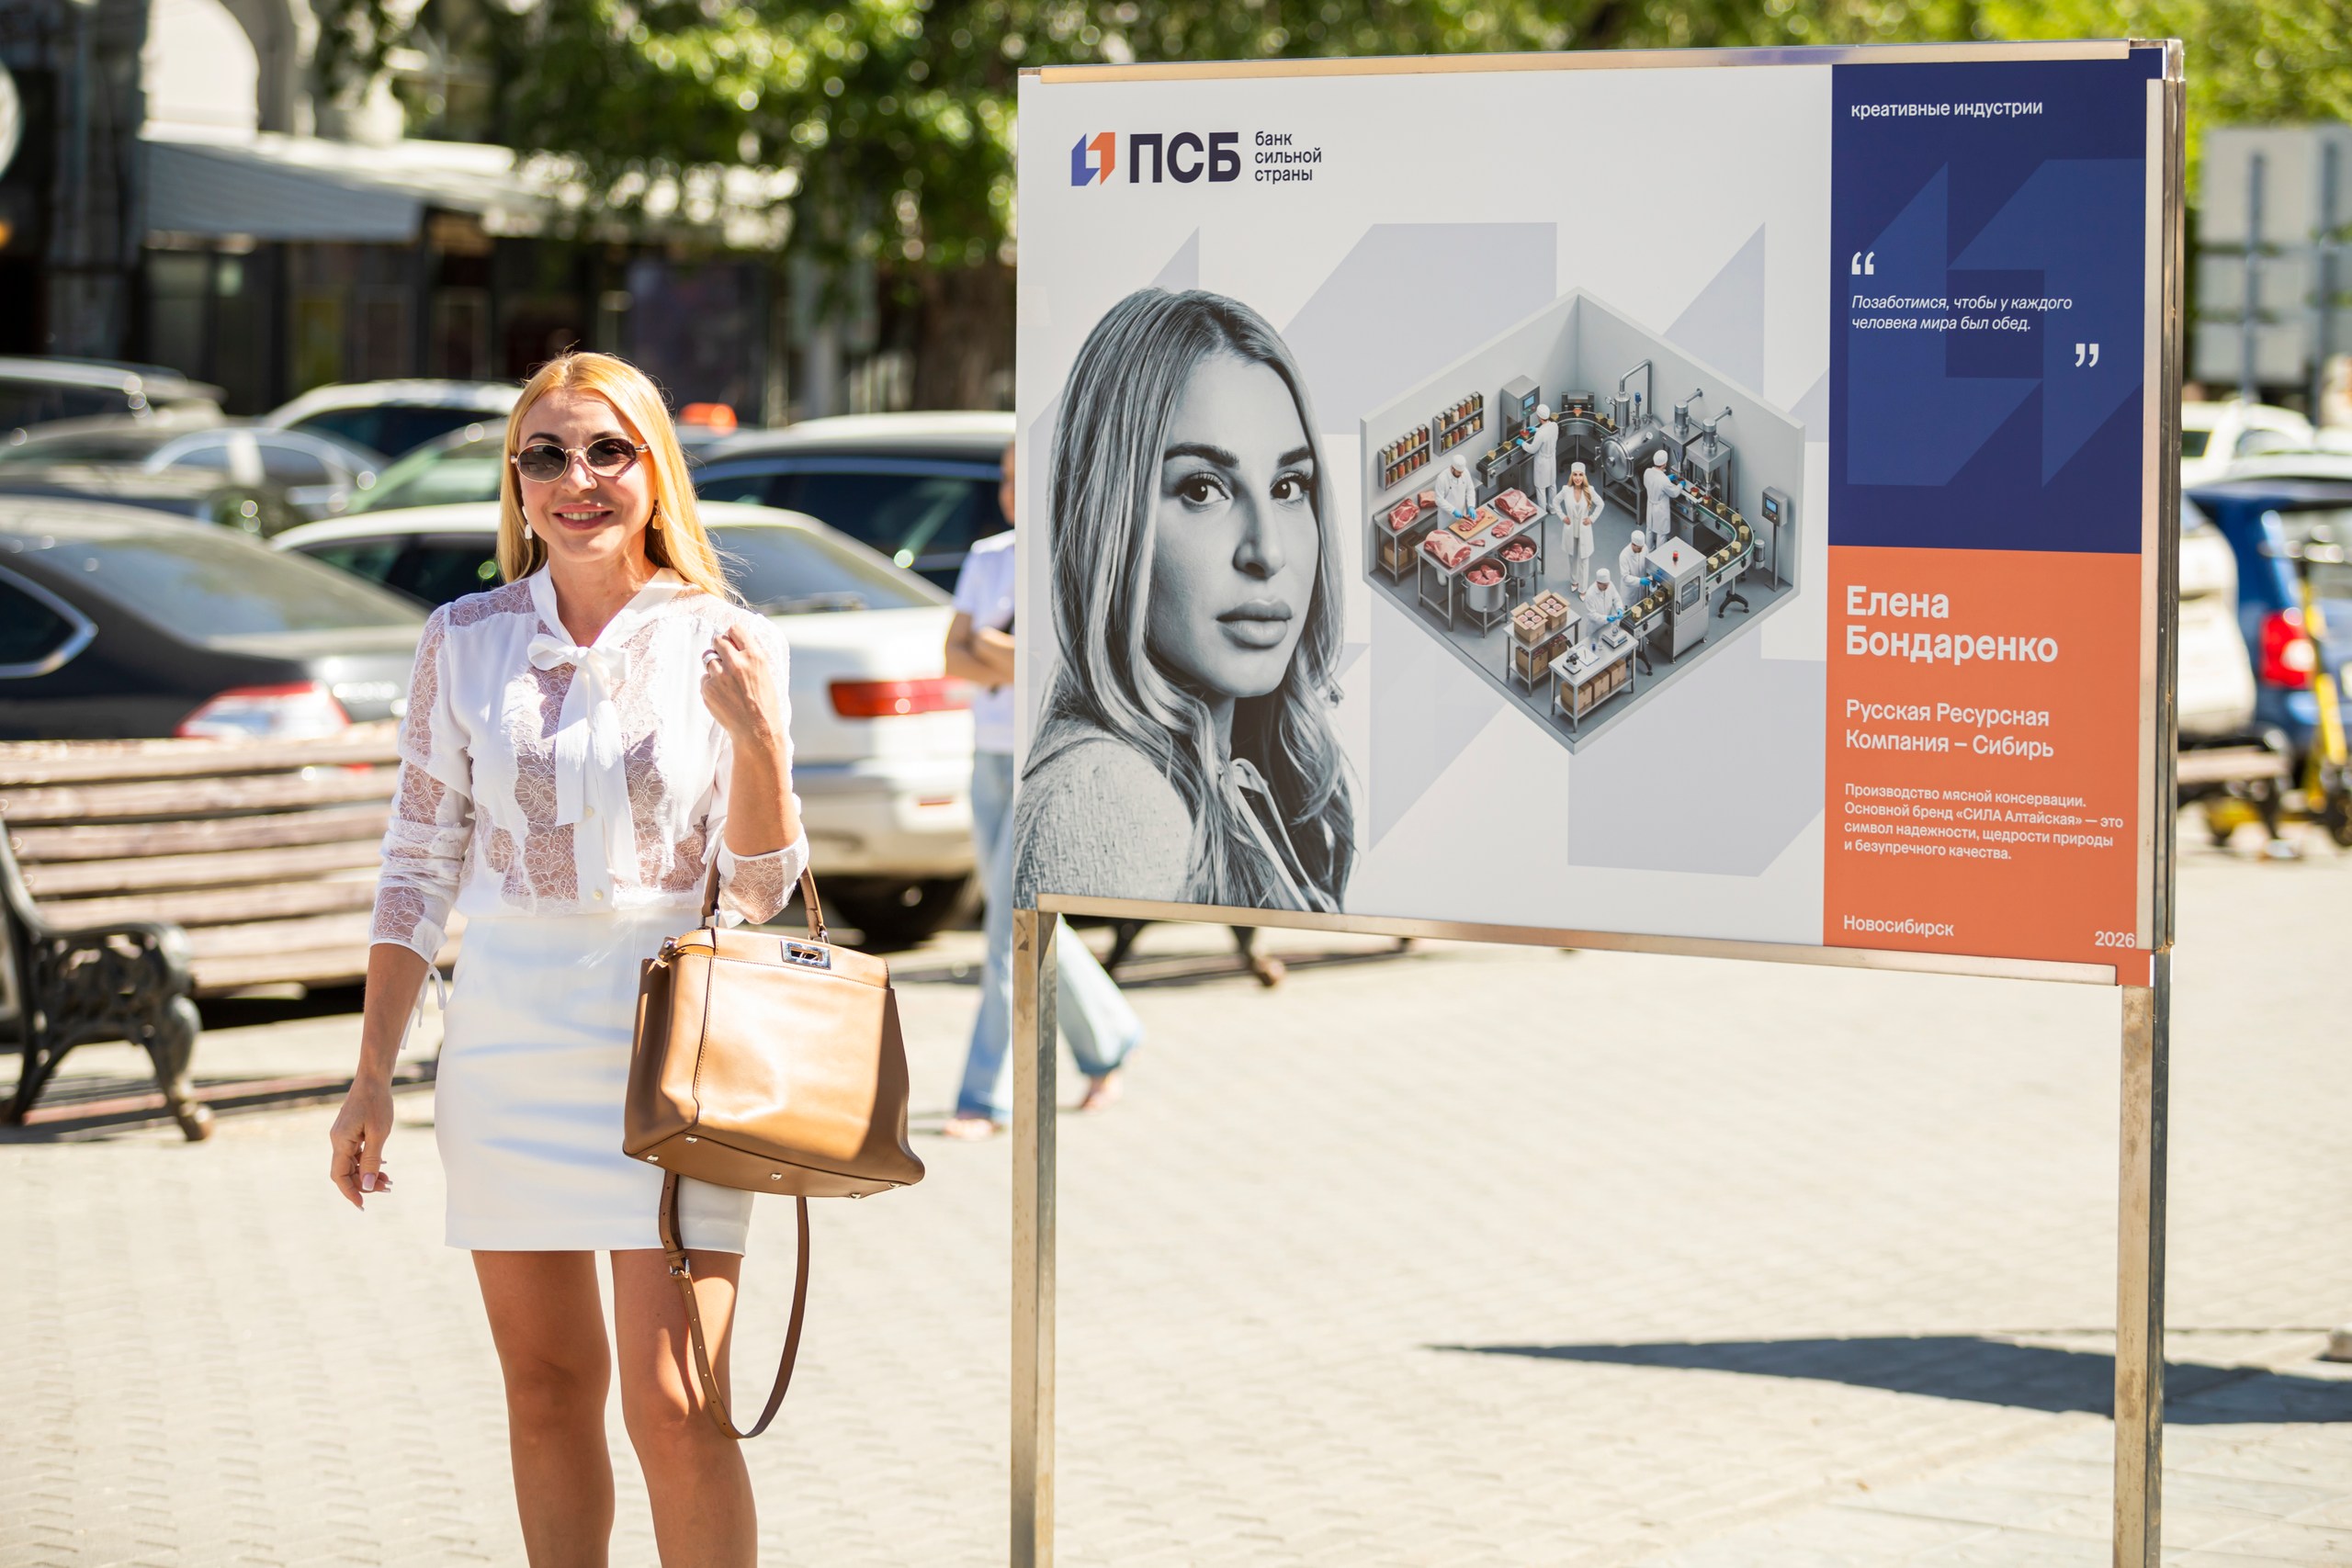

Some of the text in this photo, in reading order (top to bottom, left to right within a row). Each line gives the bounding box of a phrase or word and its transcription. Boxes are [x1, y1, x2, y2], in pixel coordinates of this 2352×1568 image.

[1852, 102, 2042, 119] креативные индустрии
[1256, 131, 1292, 146] банк
[1130, 132, 1240, 183] ПСБ
[1255, 148, 1321, 164] сильной
[1255, 169, 1312, 185] страны
[1852, 296, 2072, 311] Позаботимся, чтобы у каждого
[1852, 316, 2030, 332] человека мира был обед.
[1848, 585, 1949, 618] Елена
[1847, 625, 2058, 665] Бондаренко
[1847, 699, 2049, 728] Русская Ресурсная
[1847, 729, 1949, 751] Компания
[1973, 735, 2053, 761] Сибирь
[1846, 784, 2086, 807] Производство мясной консервации.
[1845, 802, 1909, 816] Основной
[1913, 806, 1953, 820] бренд
[1956, 807, 2002, 821] «СИЛА
[2005, 810, 2082, 825] Алтайская»
[2100, 818, 2123, 828] это
[1845, 823, 2113, 848] символ надежности, щедрости природы
[1845, 840, 2011, 859] и безупречного качества.
[1844, 915, 1953, 938] Новосибирск
[2095, 931, 2135, 948] 2026
